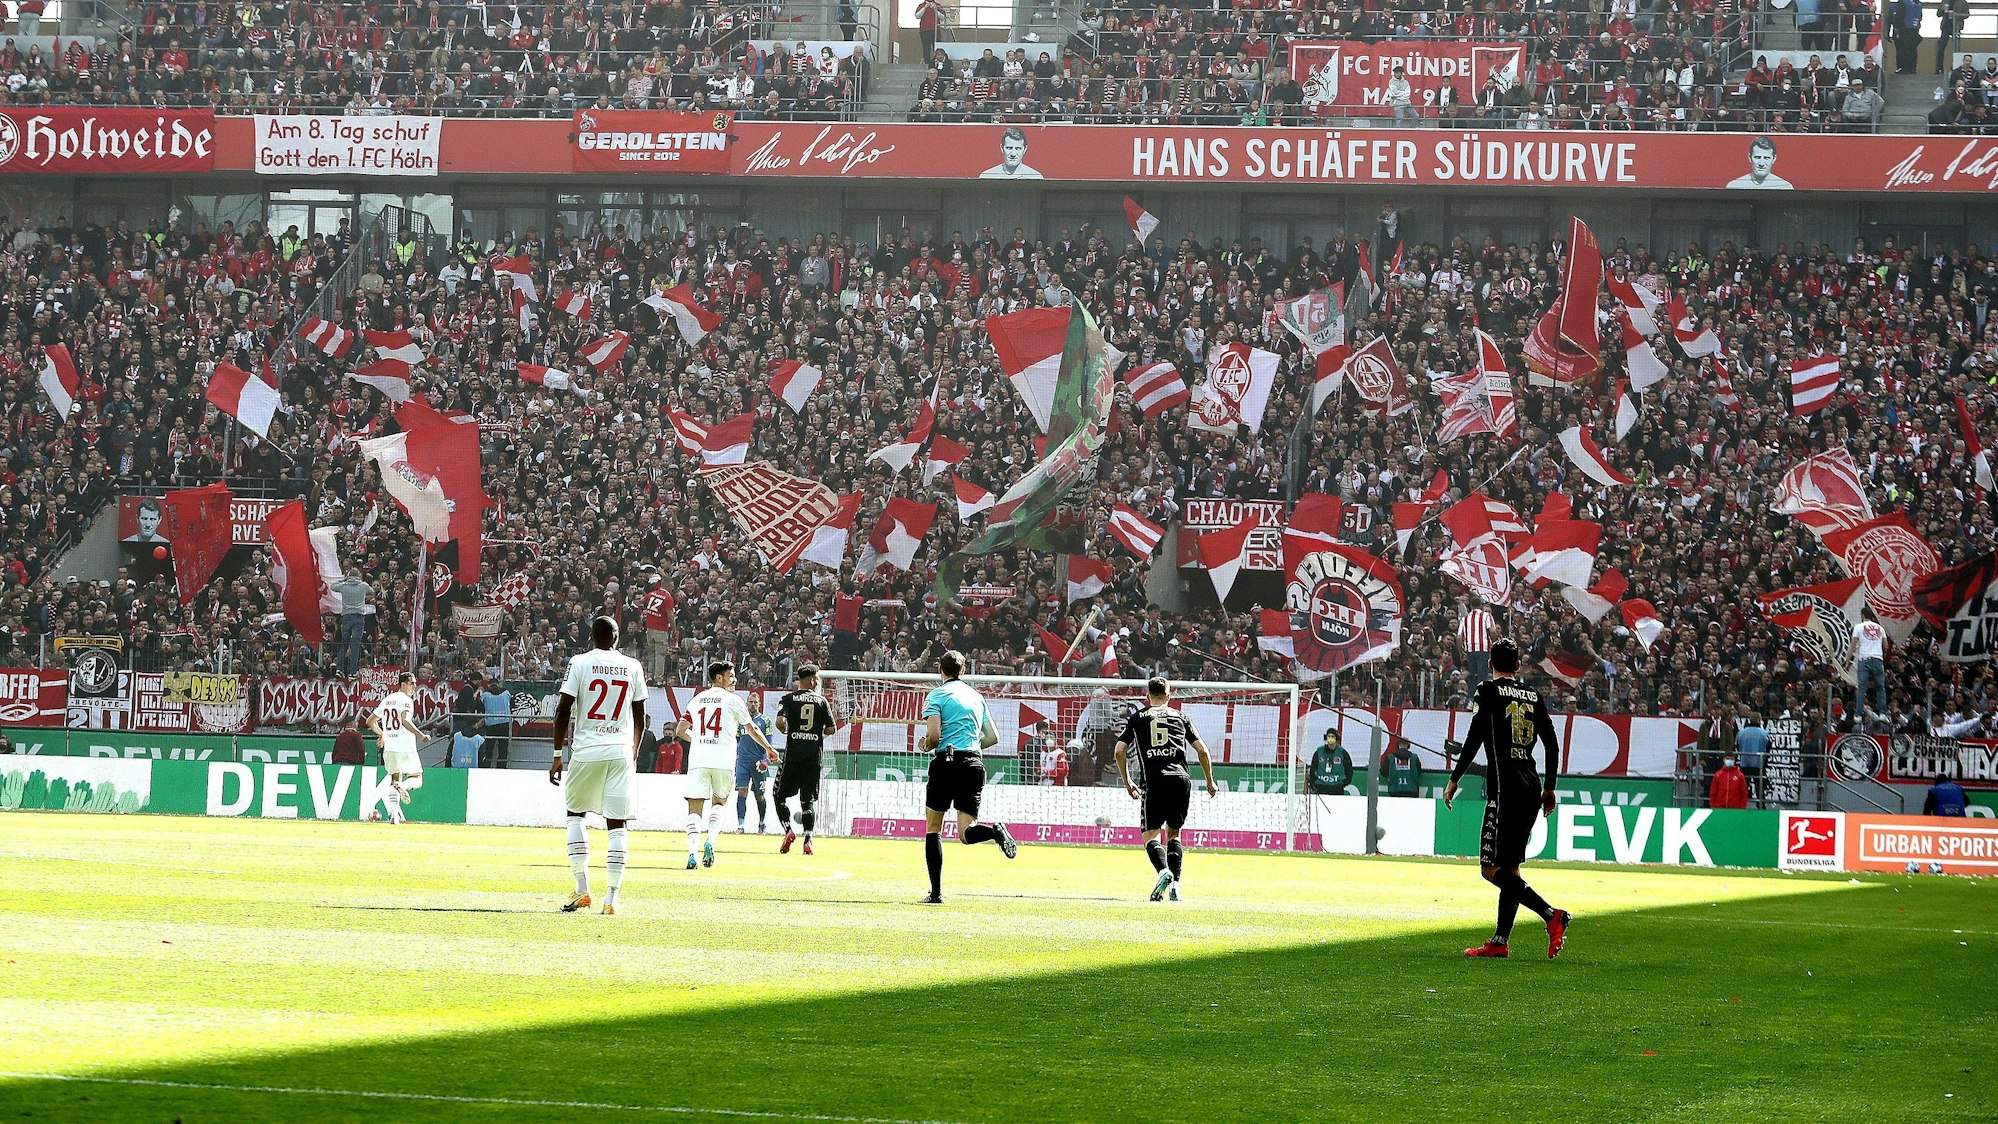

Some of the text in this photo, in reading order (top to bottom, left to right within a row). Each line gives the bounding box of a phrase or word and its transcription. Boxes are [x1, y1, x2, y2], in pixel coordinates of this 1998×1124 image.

[1343, 51, 1471, 77] FC FRÜNDE
[1363, 87, 1391, 105] MA
[24, 115, 212, 166] Holweide
[268, 118, 430, 144] Am 8. Tag schuf
[579, 131, 727, 151] GEROLSTEIN
[261, 147, 301, 167] Gott
[307, 148, 340, 167] den
[361, 148, 386, 168] FC
[390, 148, 433, 168] Köln
[619, 152, 680, 161] SINCE 2012
[1132, 131, 1637, 183] HANS SCHÄFER SÜDKURVE
[229, 501, 284, 521] SCHÄ
[1186, 501, 1283, 527] CHAOTIX
[647, 596, 664, 611] 12
[455, 611, 500, 623] Syndikat
[592, 665, 628, 677] MODESTE
[191, 675, 217, 701] DES
[219, 677, 237, 702] 99
[587, 678, 629, 721] 27
[1498, 685, 1526, 701] MAINZ
[383, 708, 400, 731] 28
[698, 707, 722, 738] 14
[799, 704, 814, 731] 9
[1505, 701, 1535, 747] 16
[1150, 717, 1169, 747] 6
[1146, 748, 1177, 759] STACH
[206, 761, 406, 822] DEVK
[1873, 833, 1933, 855] URBAN
[1786, 858, 1836, 867] BUNDESLIGA
